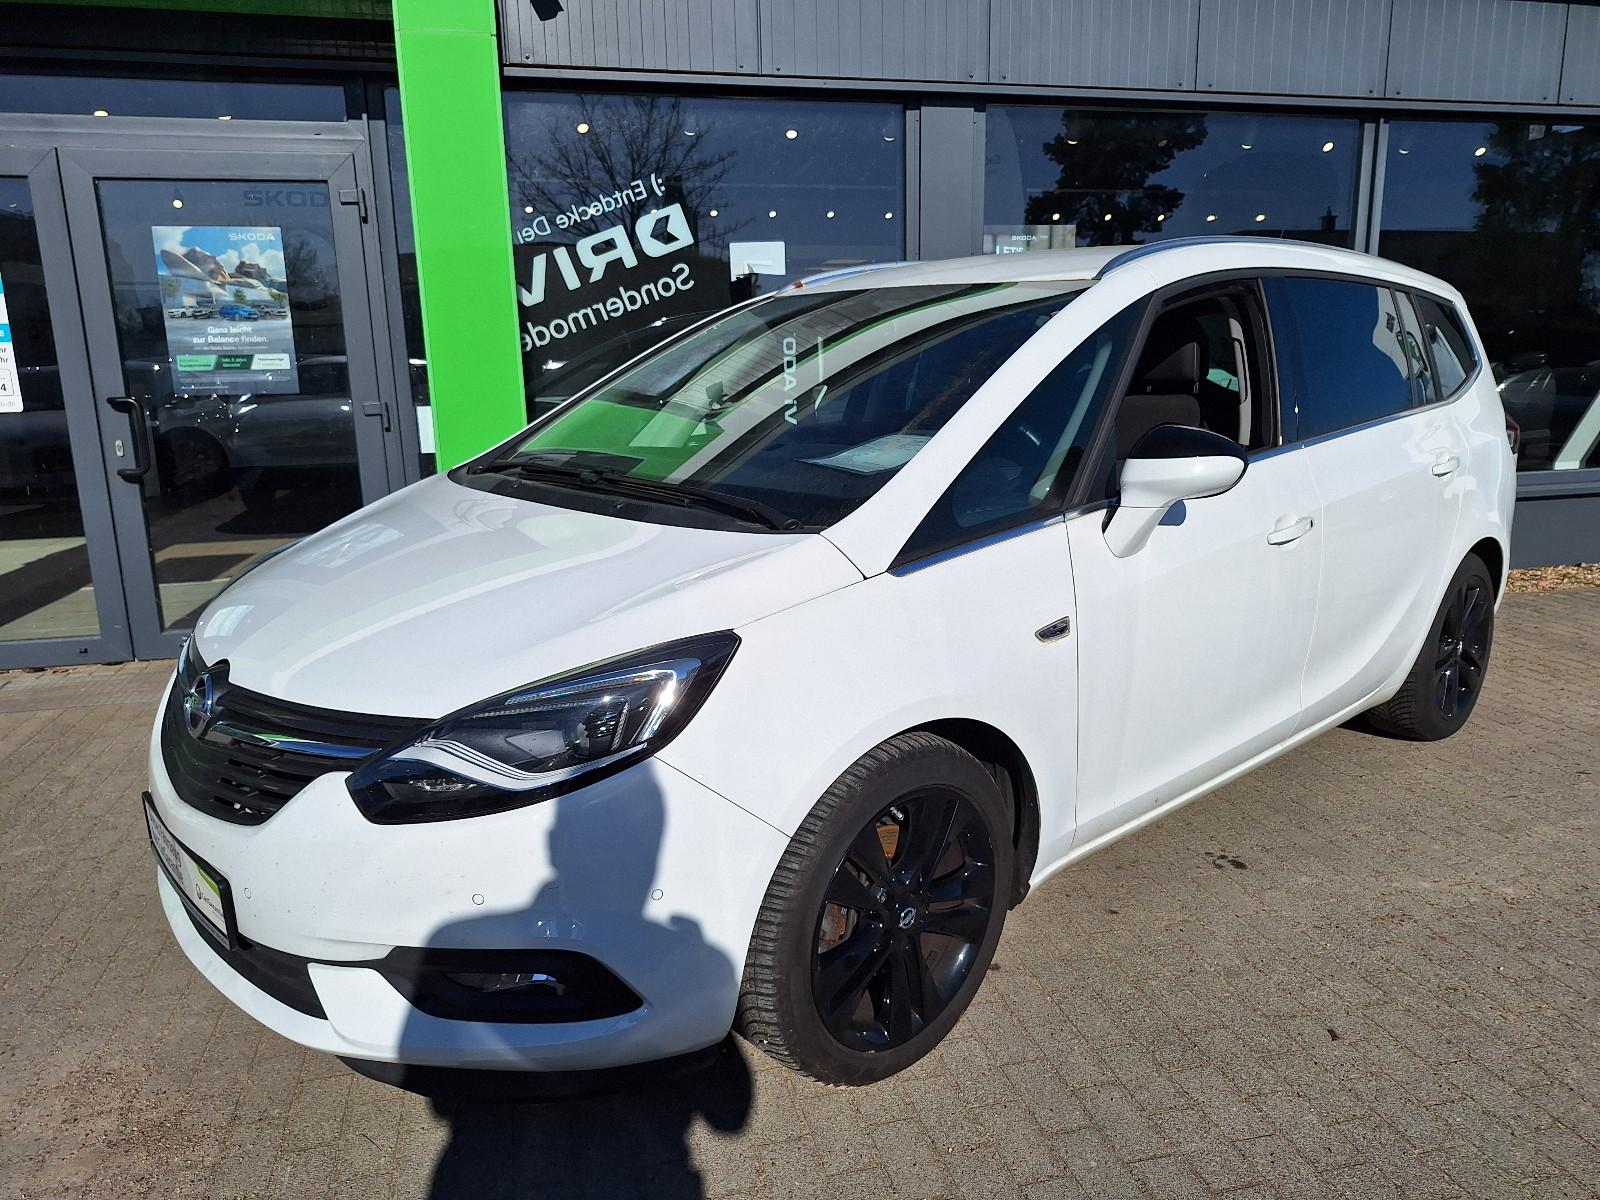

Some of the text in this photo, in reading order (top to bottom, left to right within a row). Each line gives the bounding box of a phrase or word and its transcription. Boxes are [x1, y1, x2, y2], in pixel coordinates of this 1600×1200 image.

[207, 325, 253, 334] Ganz leicht
[192, 335, 269, 344] zur Balance finden.
